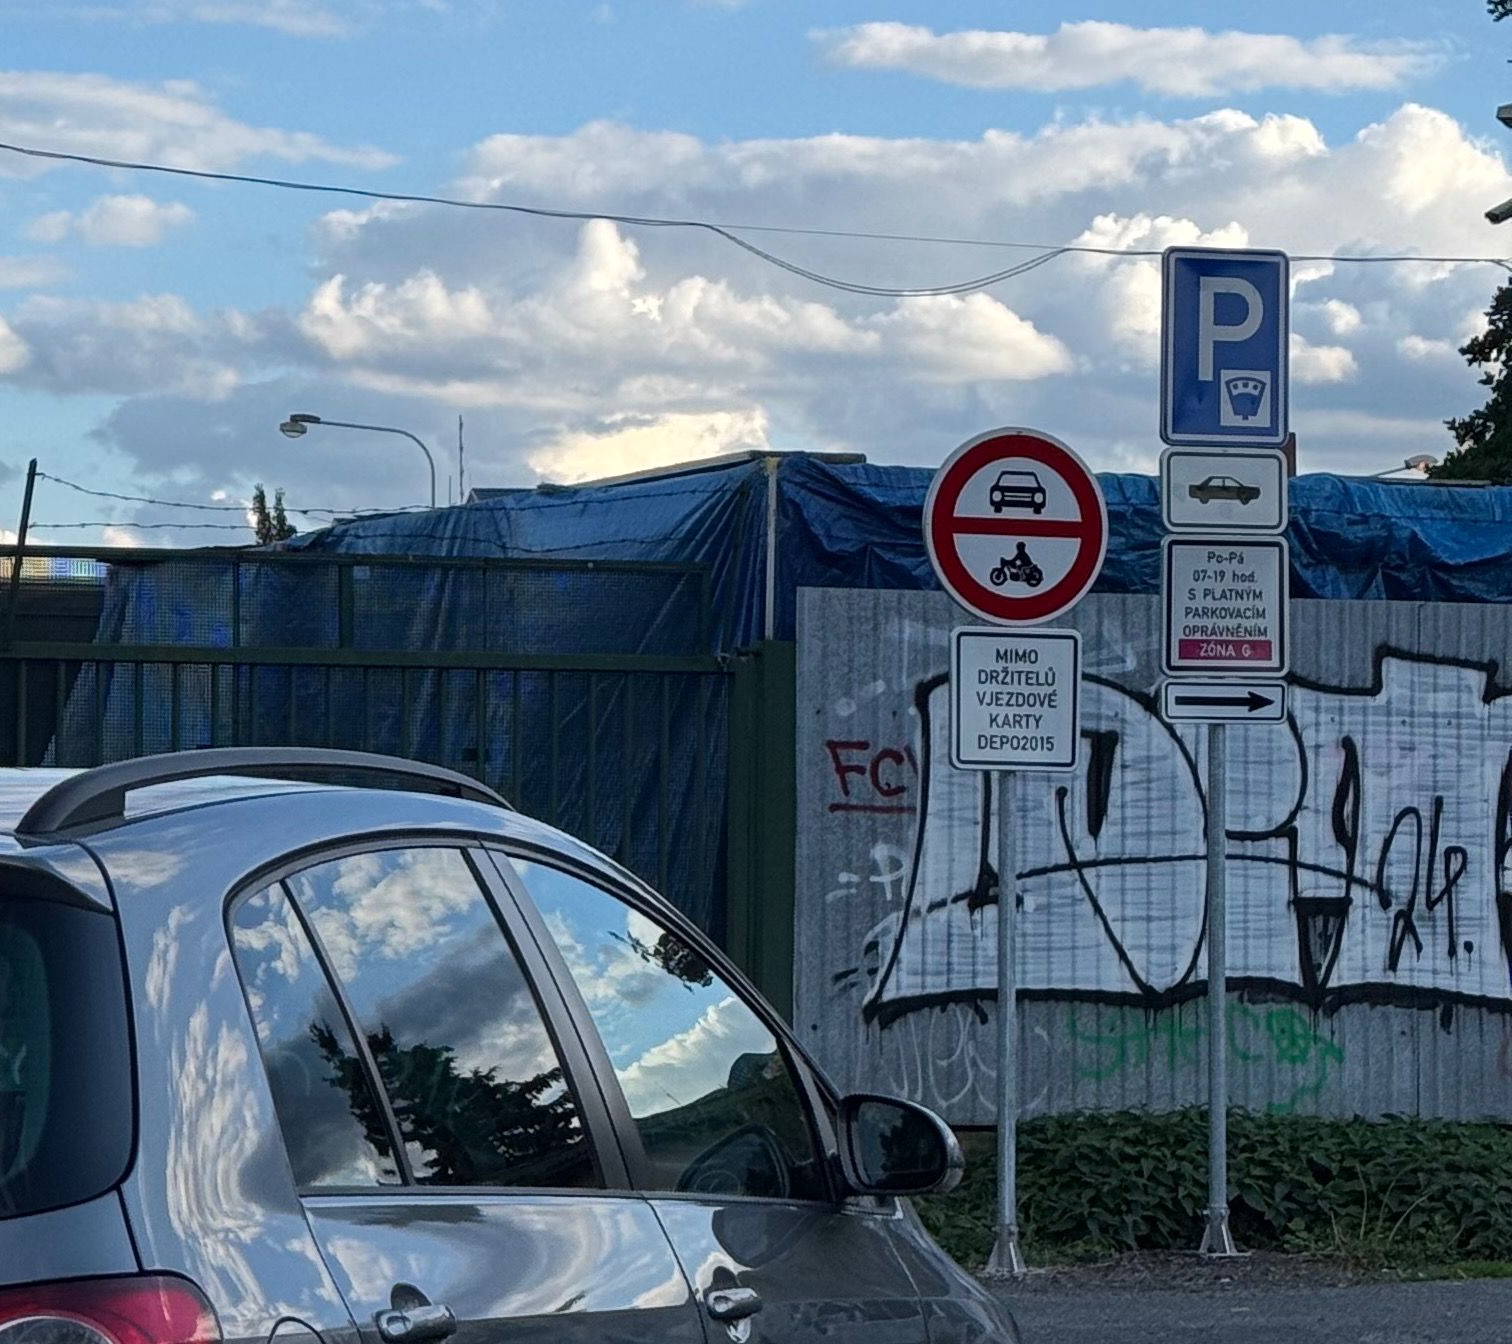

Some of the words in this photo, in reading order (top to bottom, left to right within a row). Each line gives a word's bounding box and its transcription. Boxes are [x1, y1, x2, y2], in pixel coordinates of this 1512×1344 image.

[1198, 275, 1264, 382] P
[1207, 551, 1245, 565] Po-Pá
[1192, 569, 1226, 583] 07-19
[1232, 570, 1258, 583] hod.
[1187, 588, 1196, 601] S
[1203, 586, 1264, 602] PLATNÝM
[1184, 605, 1267, 620] PARKOVACÍM
[1182, 623, 1268, 638] OPRÁVNĚNÍM
[995, 647, 1039, 664] MIMO
[1199, 641, 1236, 657] ZÓNA
[1241, 644, 1252, 657] G
[977, 666, 1056, 687] DRŽITELŮ
[976, 689, 1058, 708] VJEZDOVÉ
[989, 713, 1043, 730] KARTY
[977, 734, 1055, 752] DEPO2015
